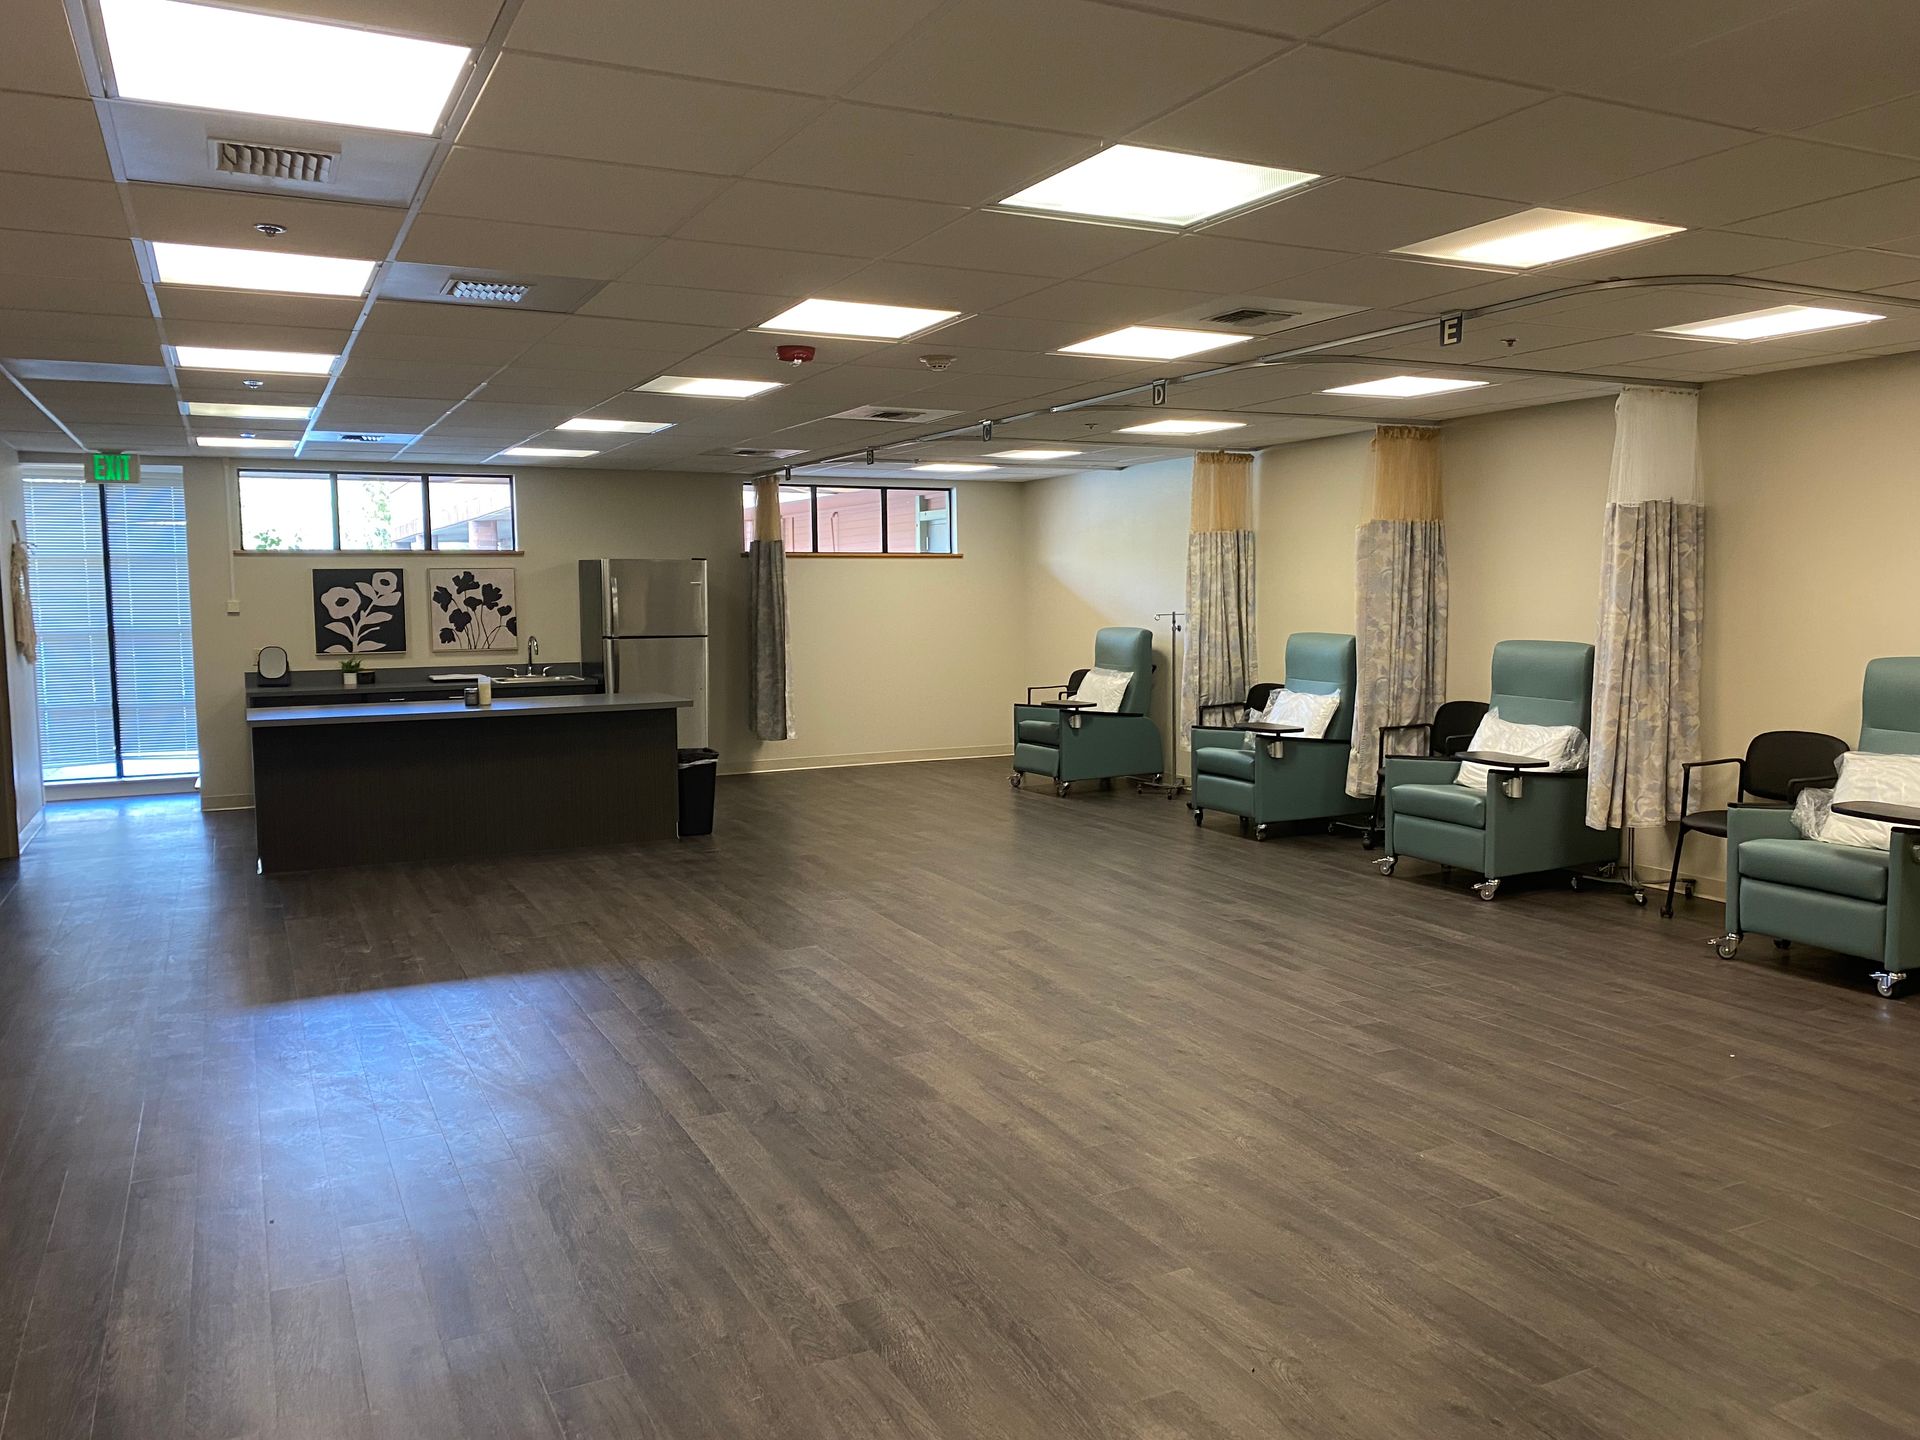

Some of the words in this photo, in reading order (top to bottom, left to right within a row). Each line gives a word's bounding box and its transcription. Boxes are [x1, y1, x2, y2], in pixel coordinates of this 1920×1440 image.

[1443, 318, 1458, 345] E
[1154, 385, 1164, 405] D
[983, 425, 990, 440] C
[93, 454, 130, 480] EXIT
